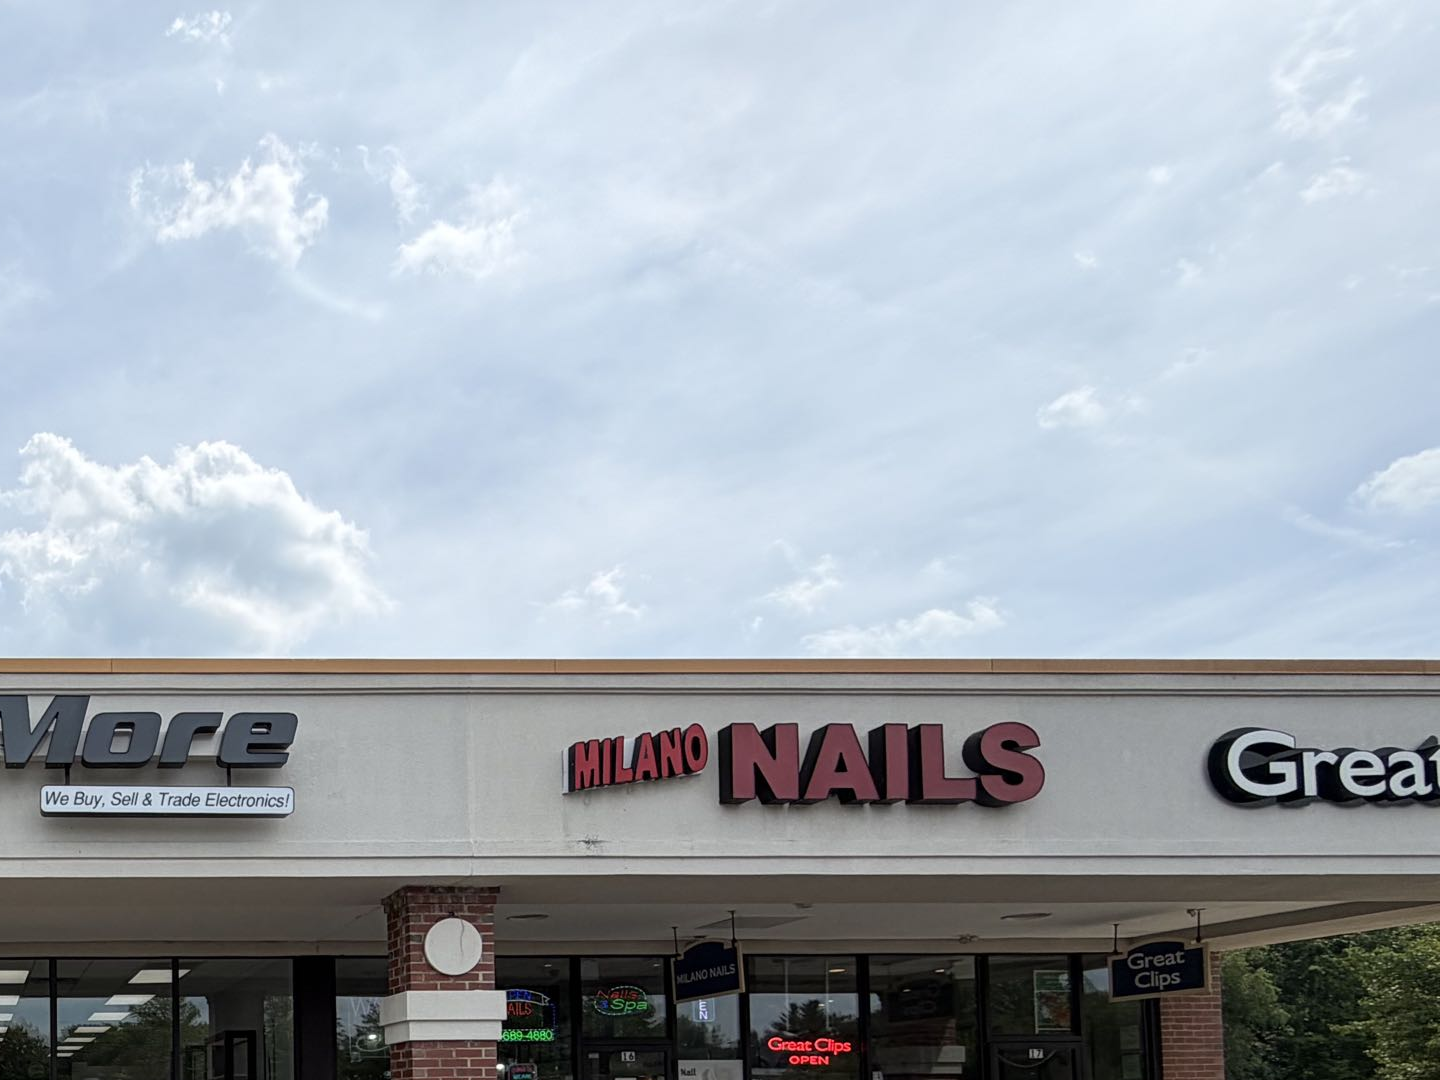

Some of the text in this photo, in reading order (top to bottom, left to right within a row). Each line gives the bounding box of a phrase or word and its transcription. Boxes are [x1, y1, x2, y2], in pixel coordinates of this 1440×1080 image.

[574, 721, 1046, 802] MILANO NAILS
[44, 790, 291, 809] We Buy, Sell & Trade Electronics!
[1127, 951, 1186, 970] Great
[676, 963, 736, 985] MILANO NAILS
[1134, 970, 1182, 990] Clips
[507, 1002, 532, 1016] AILS
[610, 998, 648, 1013] Spa
[767, 1036, 852, 1056] Great Clips
[623, 1052, 634, 1060] 16
[788, 1055, 830, 1065] OPEN
